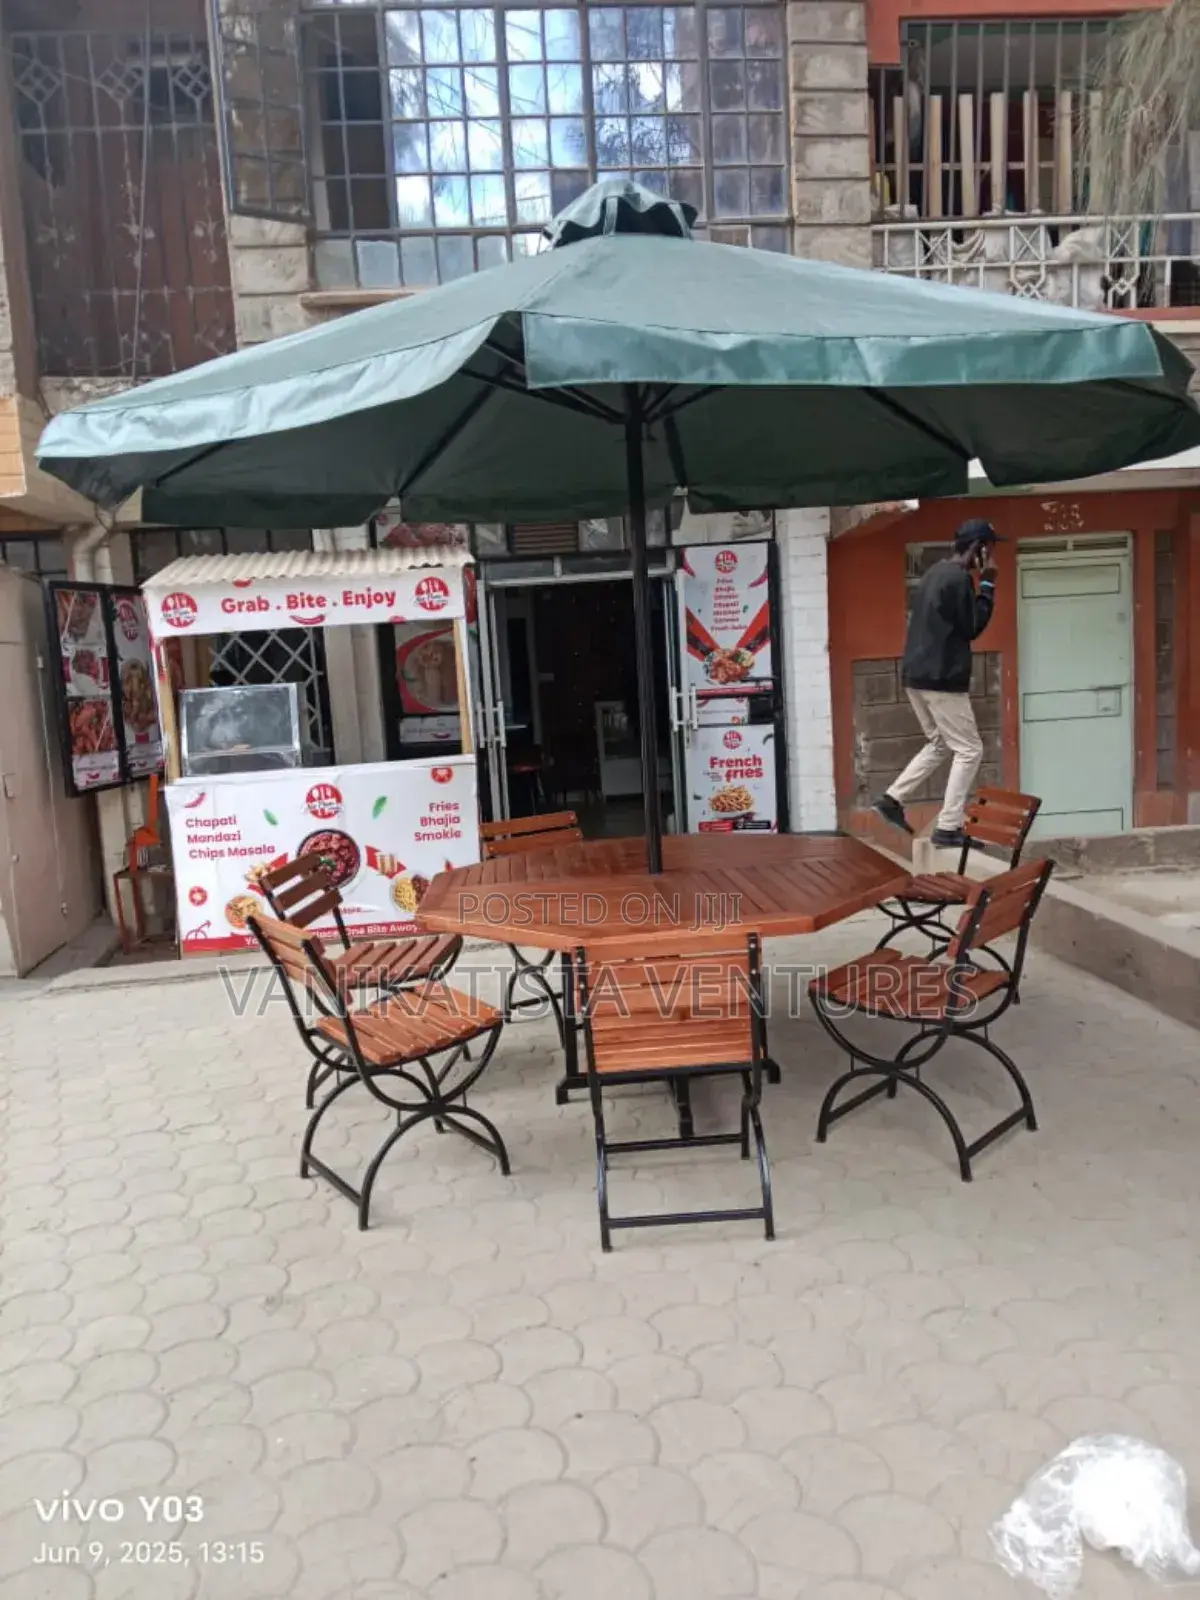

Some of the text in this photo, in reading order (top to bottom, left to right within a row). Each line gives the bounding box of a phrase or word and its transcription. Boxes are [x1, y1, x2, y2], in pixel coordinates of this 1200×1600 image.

[221, 595, 270, 613] Grab
[286, 592, 327, 609] Bite
[342, 586, 396, 609] Enjoy
[709, 754, 762, 769] French
[725, 767, 764, 783] fries
[429, 800, 460, 812] Fries
[185, 814, 236, 829] Chapati
[420, 814, 461, 828] Bhajia
[187, 830, 241, 844] Mandazi
[414, 828, 462, 841] Smokie
[189, 844, 275, 861] Chips Masala
[367, 924, 387, 934] Bite
